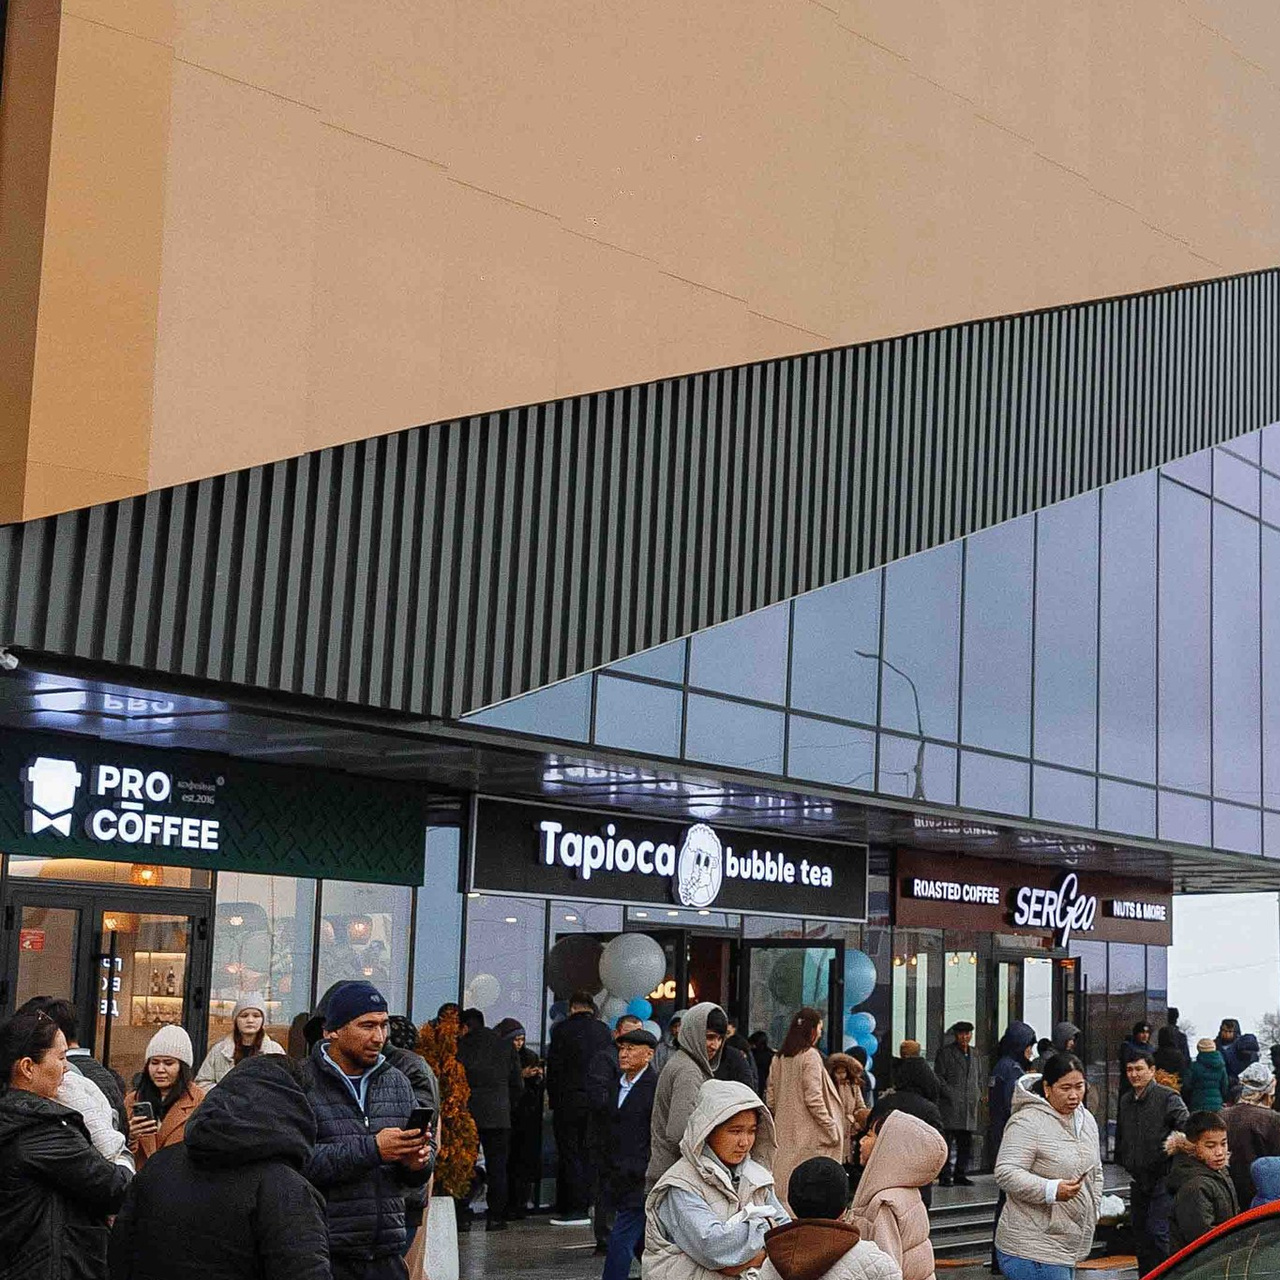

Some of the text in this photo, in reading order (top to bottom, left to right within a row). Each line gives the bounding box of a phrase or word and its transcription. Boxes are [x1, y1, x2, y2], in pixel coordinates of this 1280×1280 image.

[97, 764, 171, 802] PRO
[92, 808, 220, 850] COFFEE
[540, 821, 833, 888] Tapioca bubble tea
[913, 878, 1000, 905] ROASTED COFFEE
[1113, 899, 1135, 918] NUTS
[1143, 903, 1166, 921] MORE
